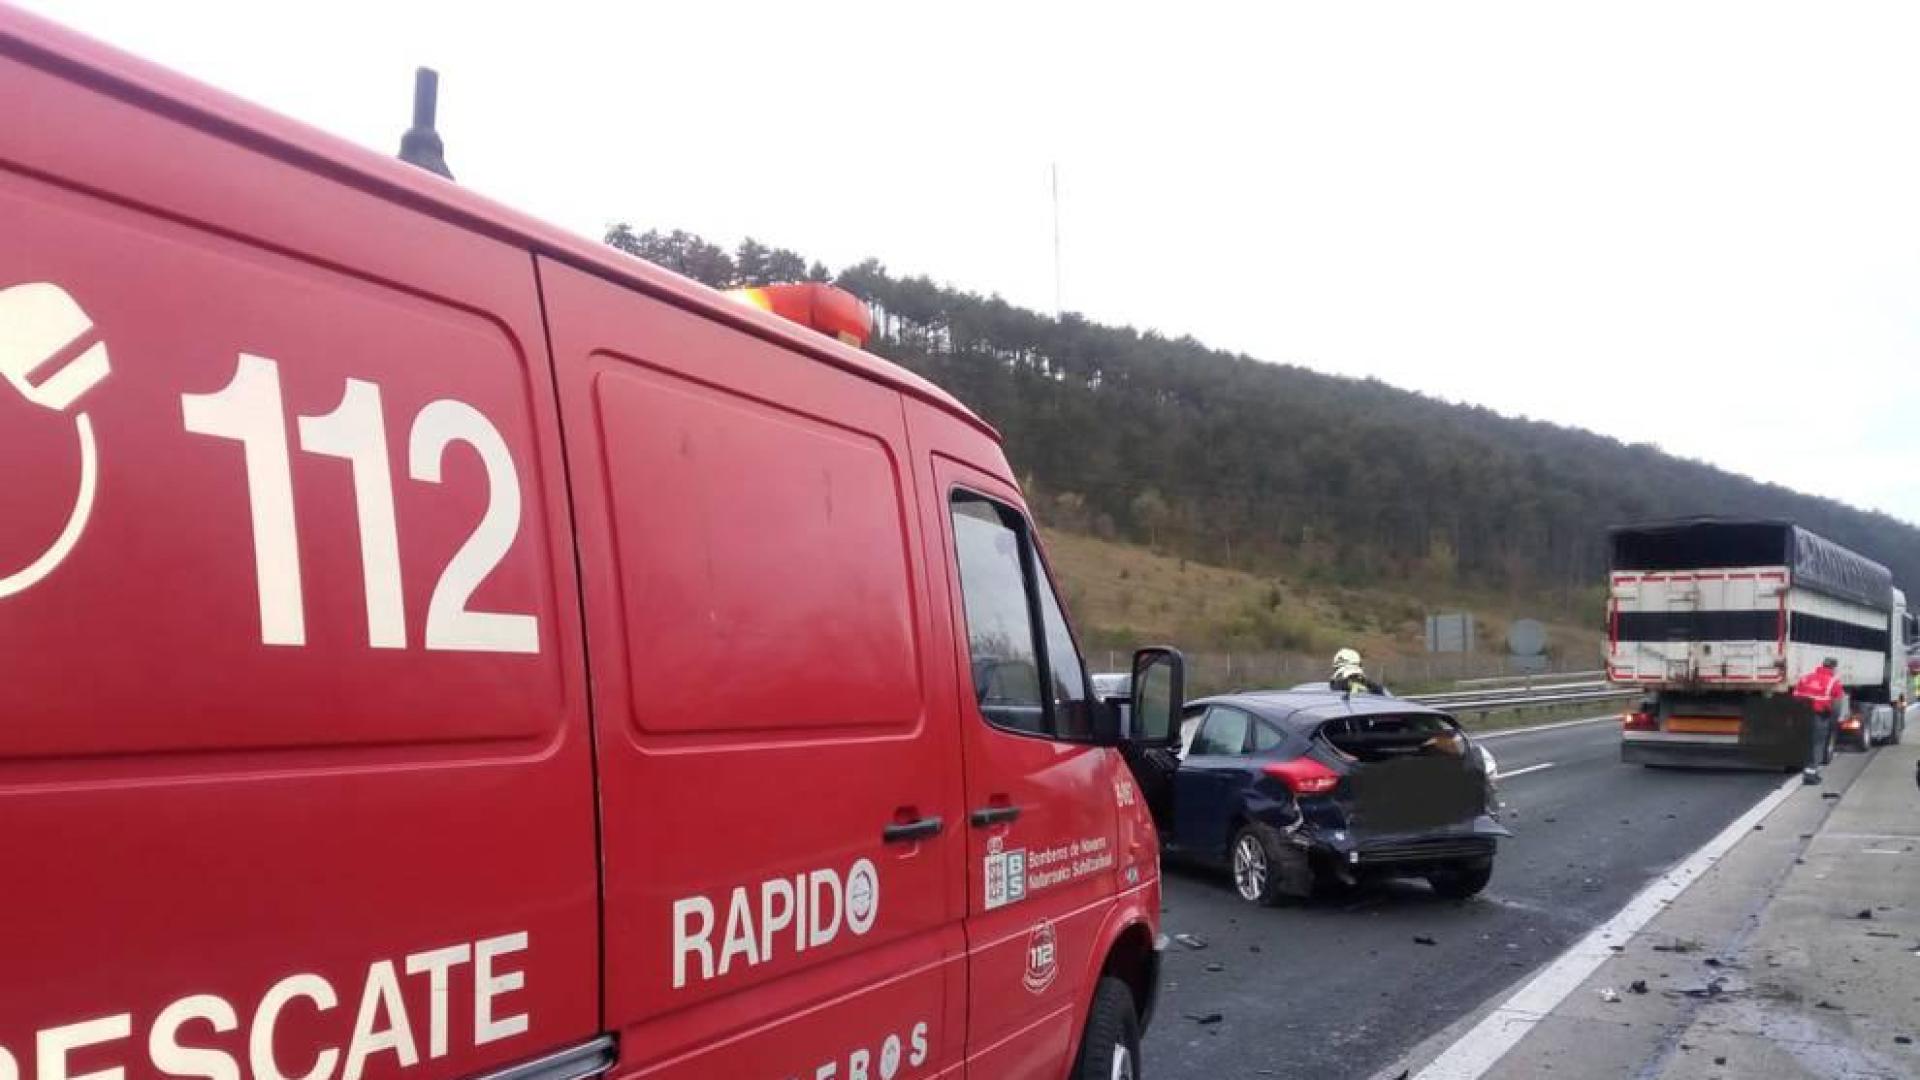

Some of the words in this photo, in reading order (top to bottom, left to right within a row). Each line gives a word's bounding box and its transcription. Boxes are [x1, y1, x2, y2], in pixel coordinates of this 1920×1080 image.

[180, 352, 540, 654] 112
[672, 858, 880, 988] RAPIDO
[1009, 854, 1023, 874] B
[0, 931, 529, 1080] ESCATE
[1031, 943, 1053, 969] 112
